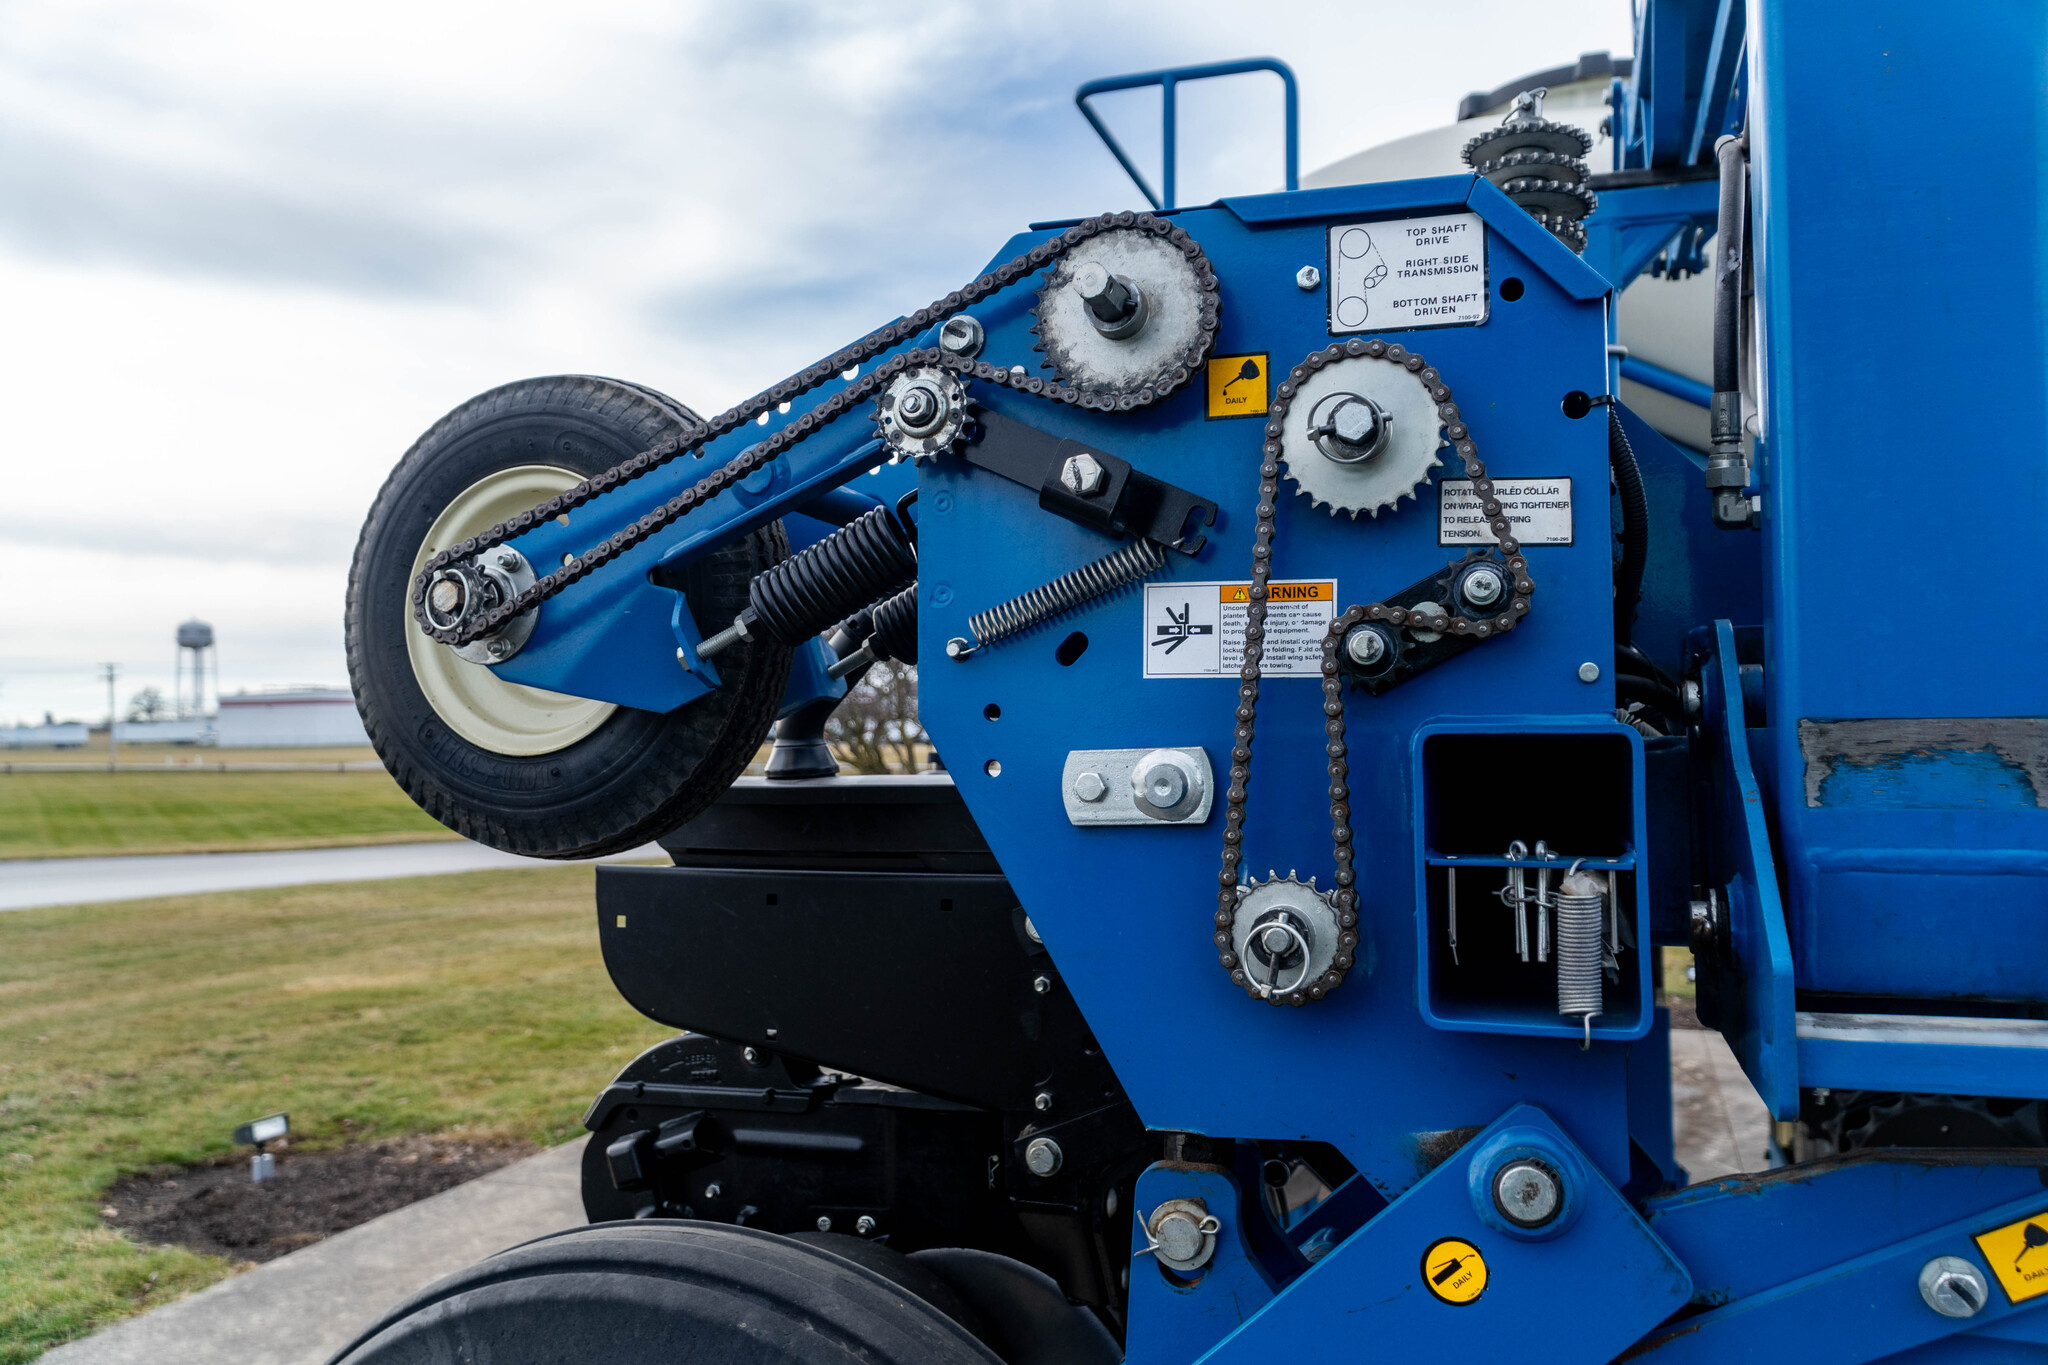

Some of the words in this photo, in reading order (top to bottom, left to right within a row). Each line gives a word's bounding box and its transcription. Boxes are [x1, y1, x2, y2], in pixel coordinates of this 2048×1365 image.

[1406, 228, 1427, 237] TOP
[1431, 224, 1468, 235] SHAFT
[1416, 235, 1450, 246] DRIVE
[1405, 257, 1438, 268] RIGHT
[1443, 255, 1469, 264] SIDE
[1397, 264, 1479, 278] TRANSMISSION
[1393, 297, 1438, 308] BOTTOM
[1441, 293, 1478, 304] SHAFT
[1414, 306, 1456, 317] DRIVEN
[1225, 396, 1248, 405] DAILY
[1523, 487, 1560, 496] COLLAR
[1443, 502, 1457, 510] ON
[1520, 501, 1570, 509] TIGHTENER
[1443, 516, 1456, 524] TO
[1456, 516, 1490, 524] RELEAS
[1443, 530, 1482, 538] TENSION.
[1248, 586, 1319, 599] RNING
[1273, 627, 1310, 635] equipment.
[1452, 1270, 1473, 1290] DAILY
